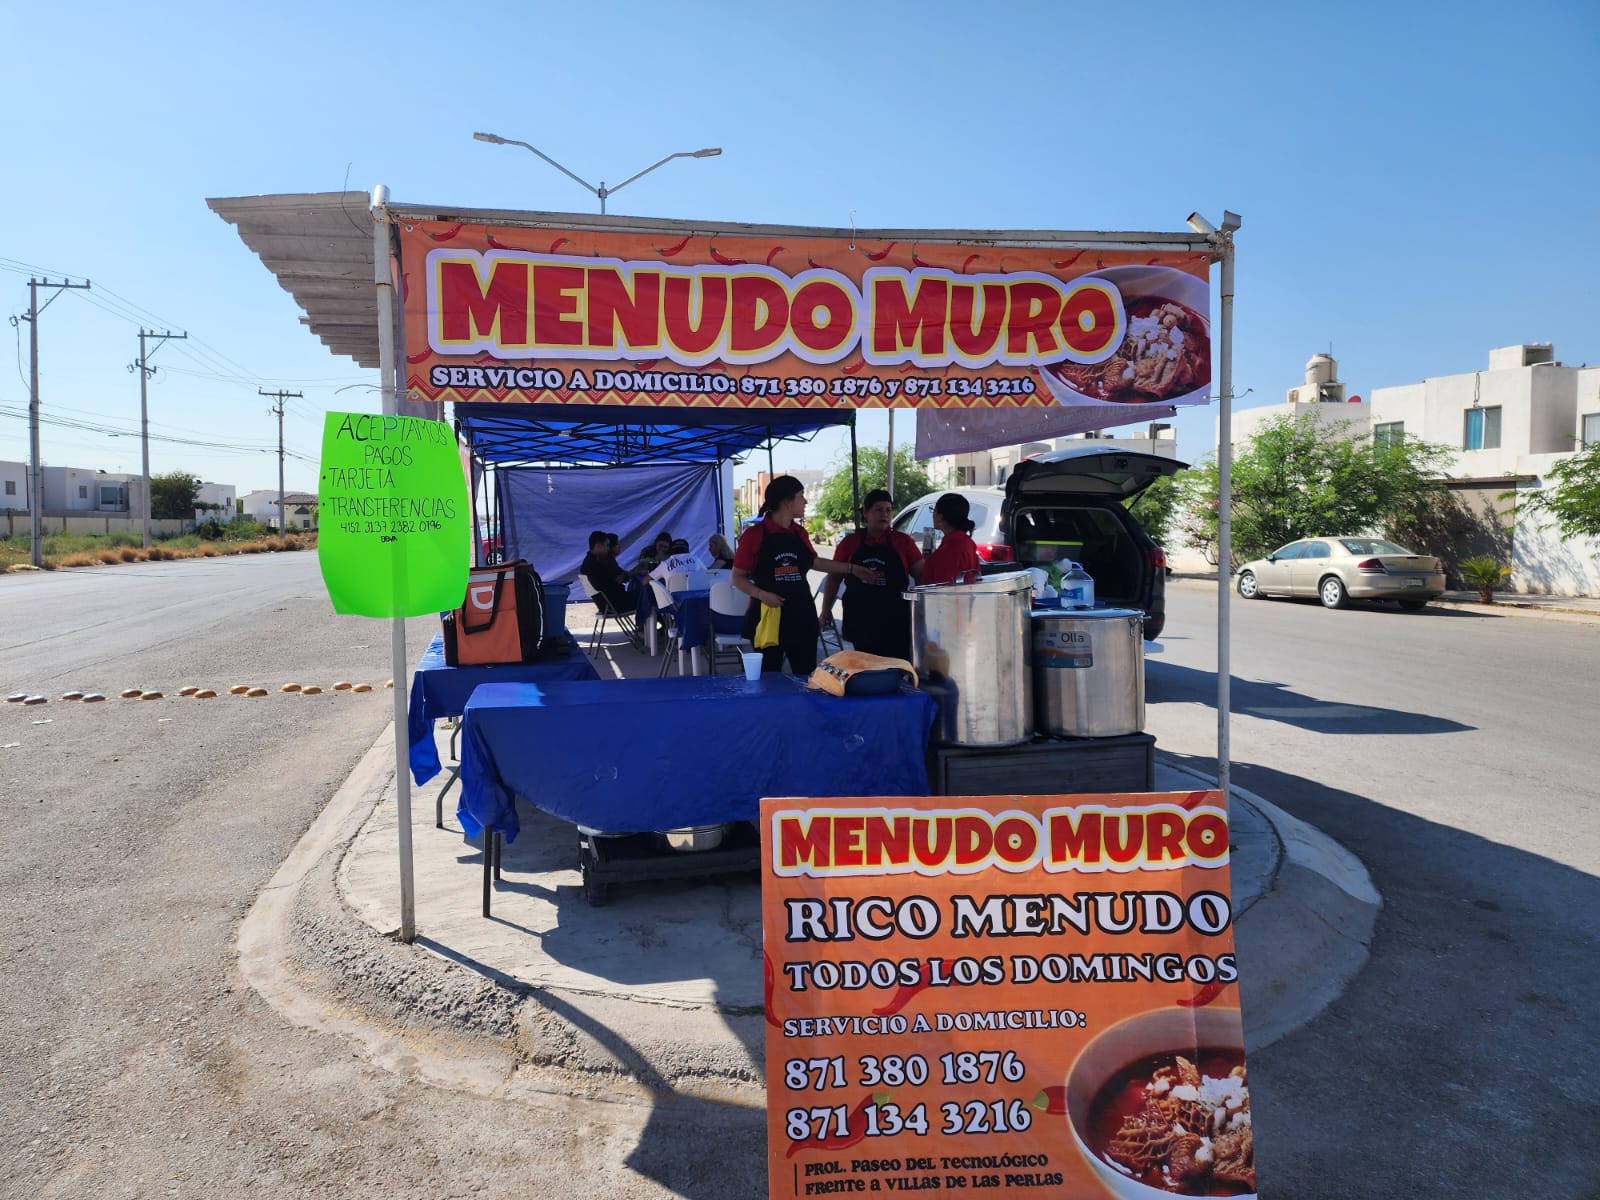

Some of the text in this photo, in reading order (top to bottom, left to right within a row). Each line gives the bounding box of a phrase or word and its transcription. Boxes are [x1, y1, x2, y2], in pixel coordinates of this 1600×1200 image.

[438, 258, 1118, 358] MENUDO MURO
[430, 365, 1036, 399] SERVICIO A DOMICILIO: 871 380 1876 y 871 134 3216
[336, 414, 448, 445] ACEPTAMOS
[363, 445, 413, 466] PAGOS
[328, 467, 396, 490] TARJETA
[328, 496, 456, 519] TRANSFERENCIAS
[340, 521, 361, 533] 4152
[391, 520, 416, 533] 2382
[1060, 632, 1085, 643] Olla
[778, 809, 1229, 869] MENUDO MURO
[784, 890, 1231, 943] RICO MENUDO
[784, 951, 1238, 991] TODOS LOS DOMINGOS
[783, 1010, 1087, 1038] SERVICIO A DOMICILIO:
[784, 1051, 1025, 1090] 871 380 1876
[785, 1100, 1032, 1141] 871 134 3216
[804, 1160, 846, 1176] PROL.
